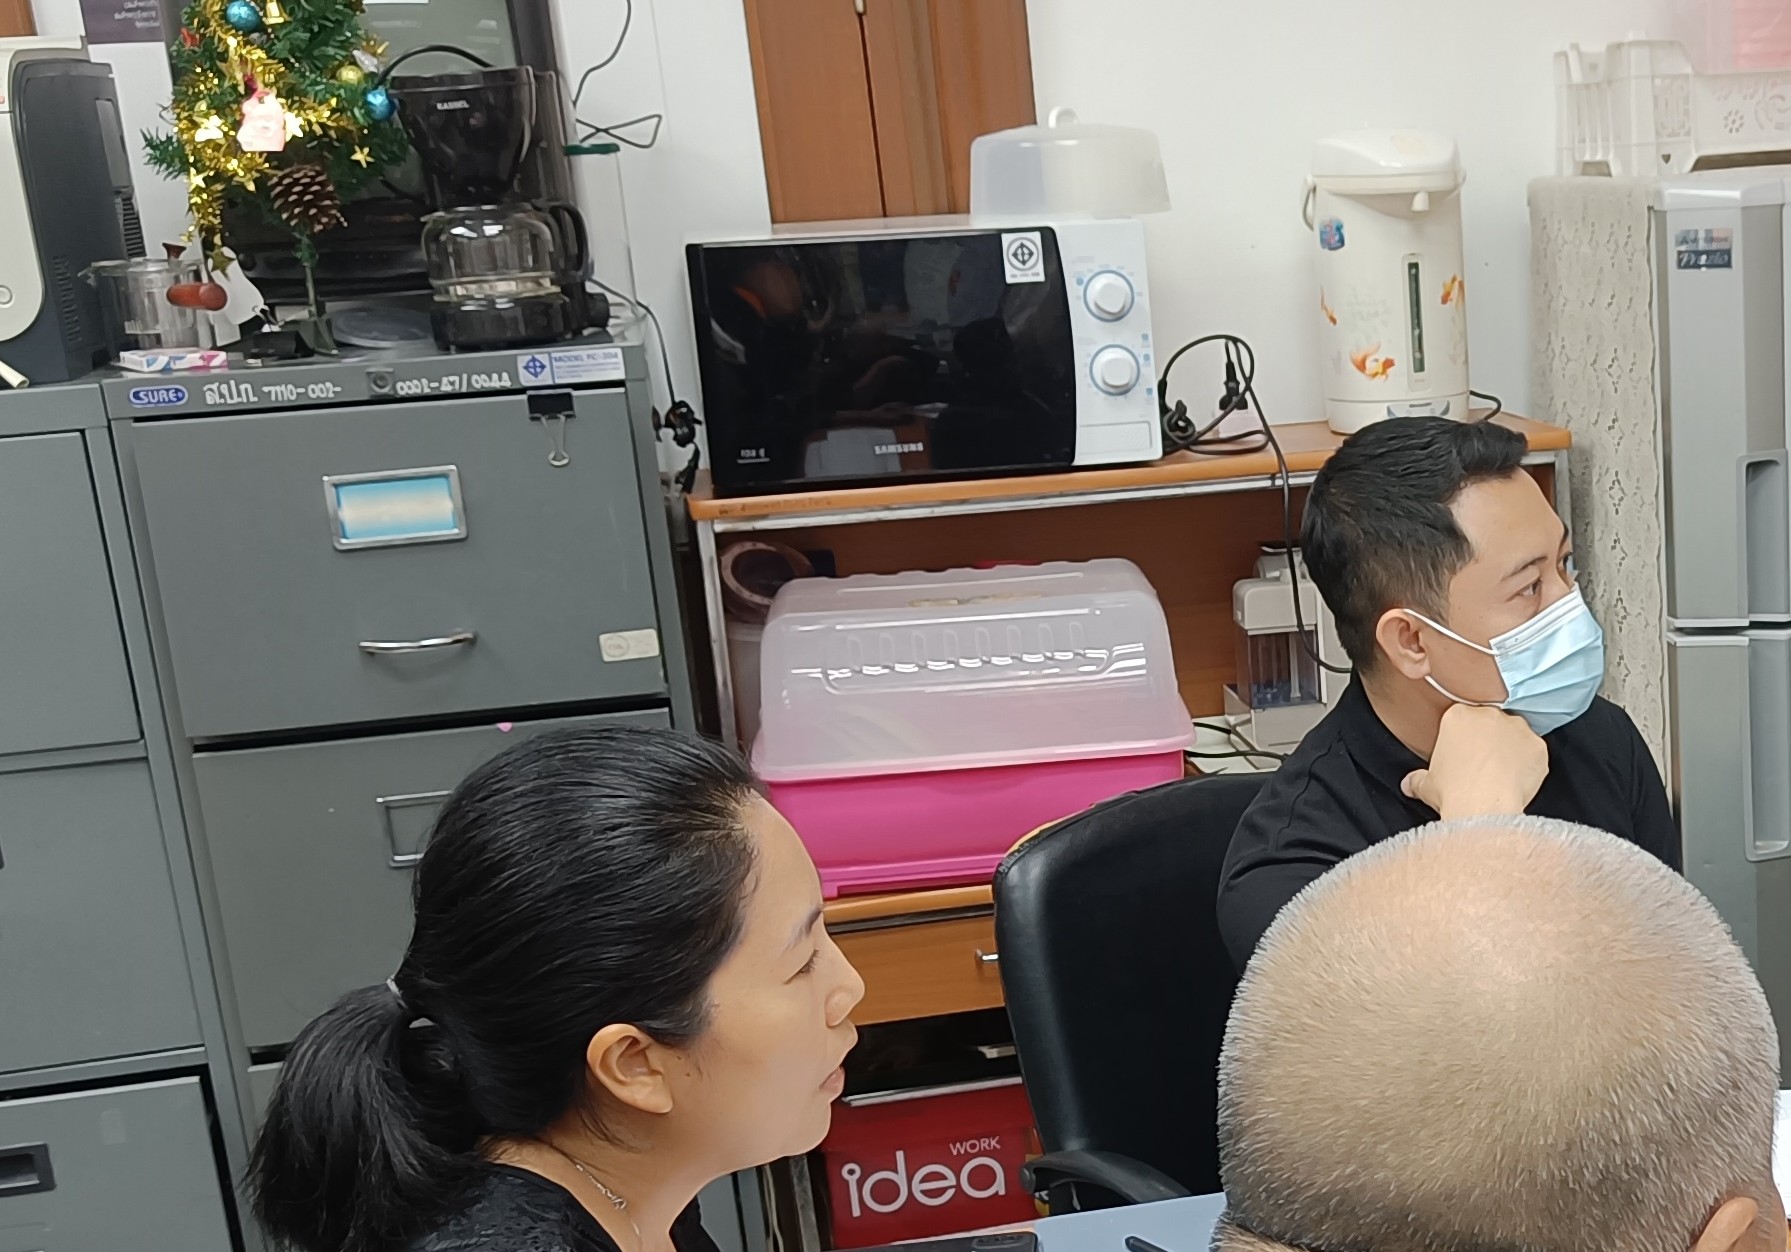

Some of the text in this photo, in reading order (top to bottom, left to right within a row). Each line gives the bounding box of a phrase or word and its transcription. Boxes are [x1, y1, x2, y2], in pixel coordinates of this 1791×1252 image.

[138, 387, 179, 404] SURE
[949, 1135, 1001, 1157] WORK
[841, 1149, 1006, 1218] idea
